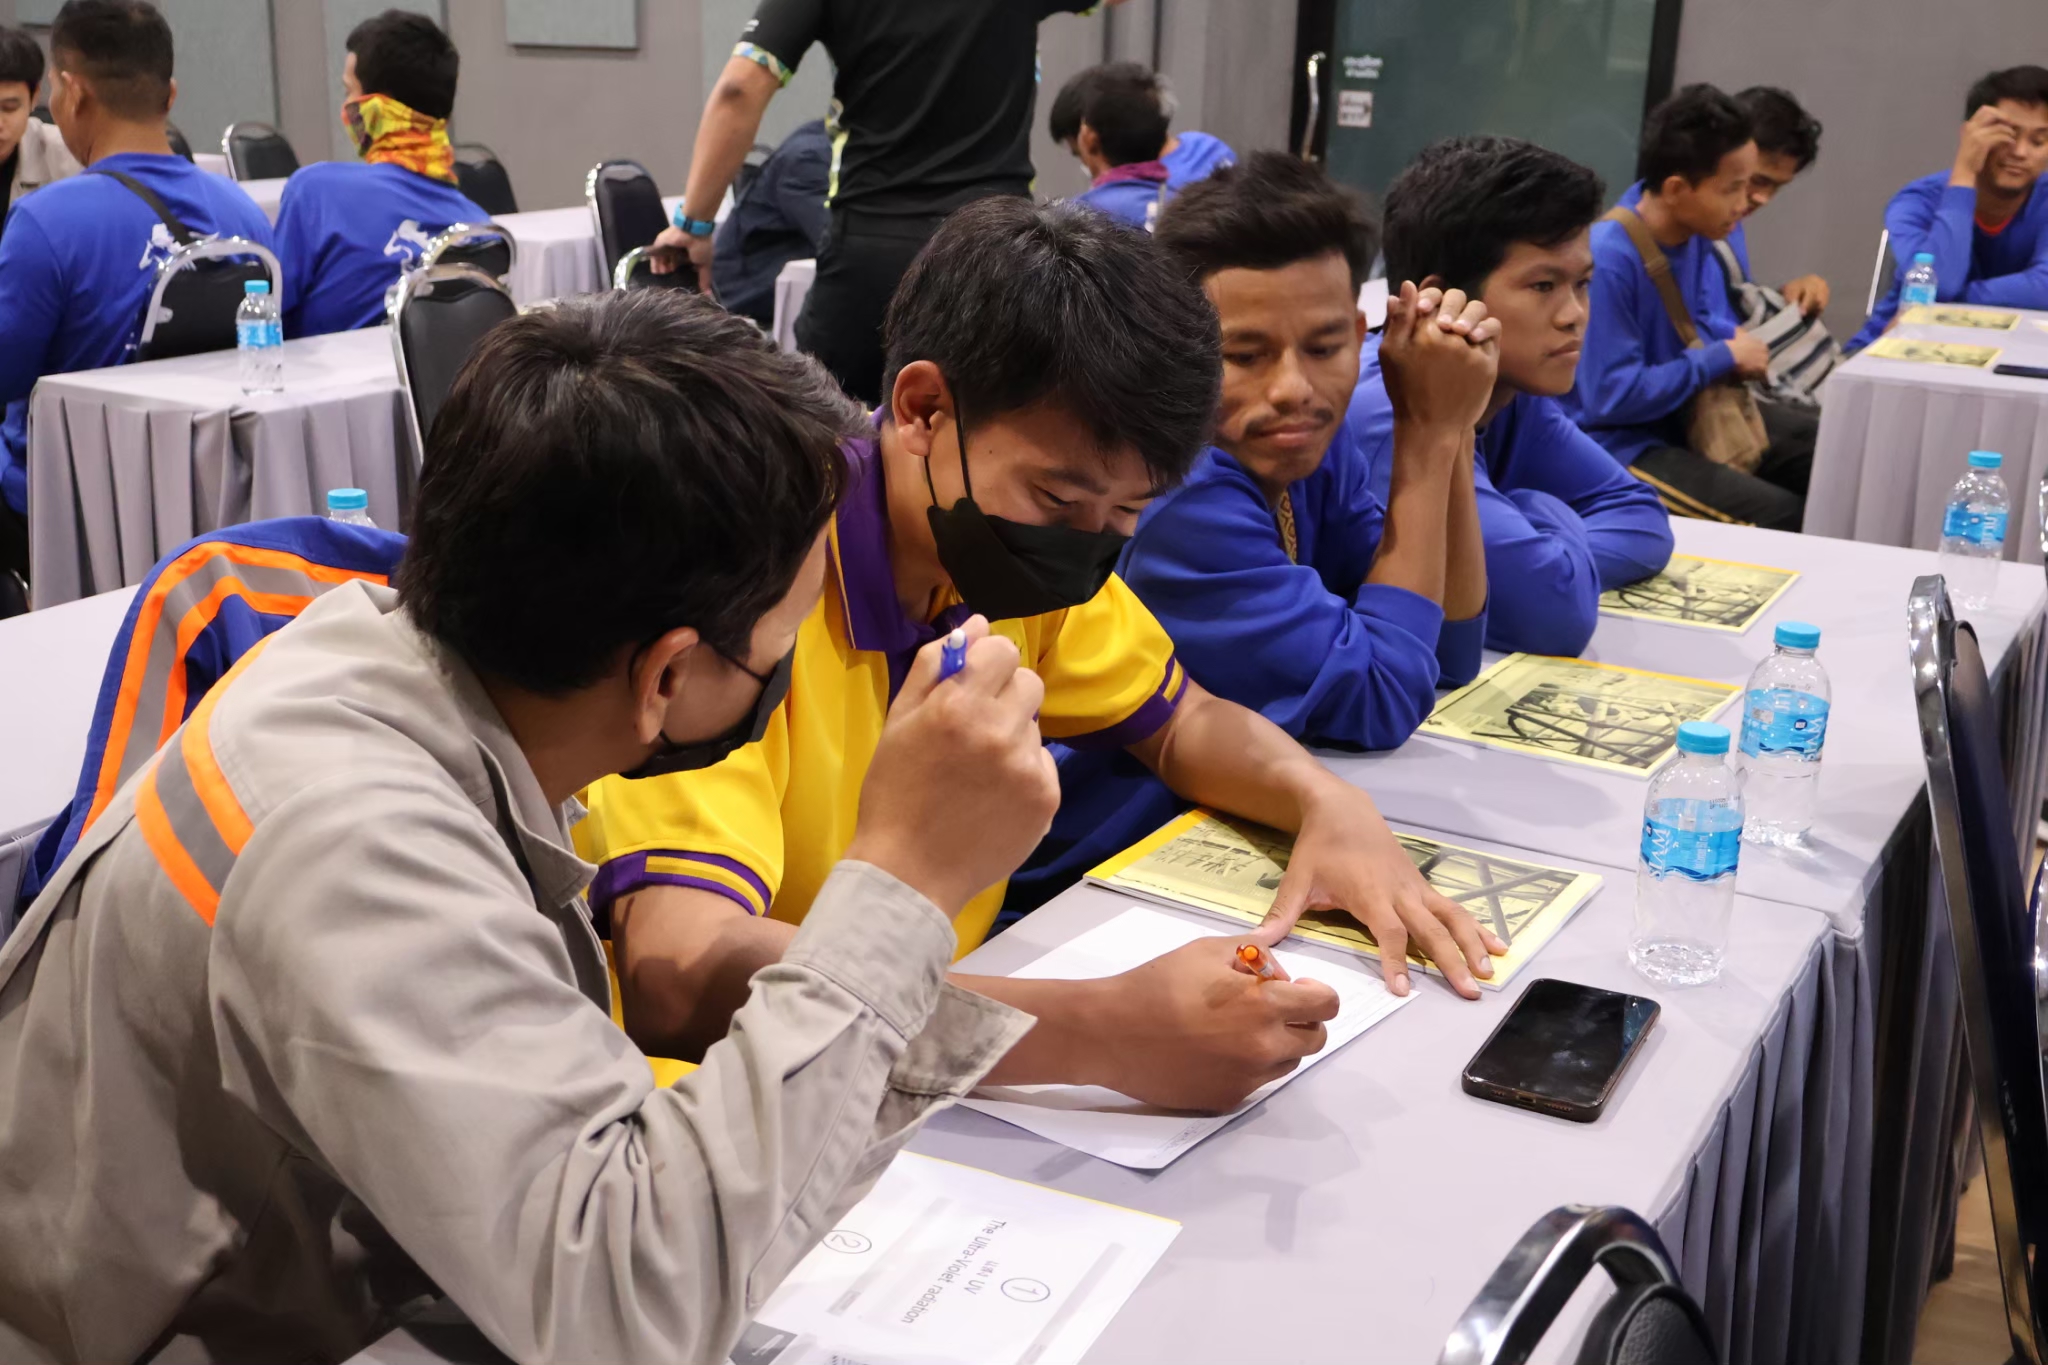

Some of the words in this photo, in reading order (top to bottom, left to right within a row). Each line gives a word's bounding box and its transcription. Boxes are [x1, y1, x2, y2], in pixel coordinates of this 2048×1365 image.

[1803, 717, 1824, 761] SIAM
[1648, 828, 1670, 879] SIAM
[982, 1219, 1007, 1234] The
[938, 1236, 991, 1283] Ultra-Violet
[901, 1284, 943, 1324] radiation
[964, 1279, 985, 1295] UV
